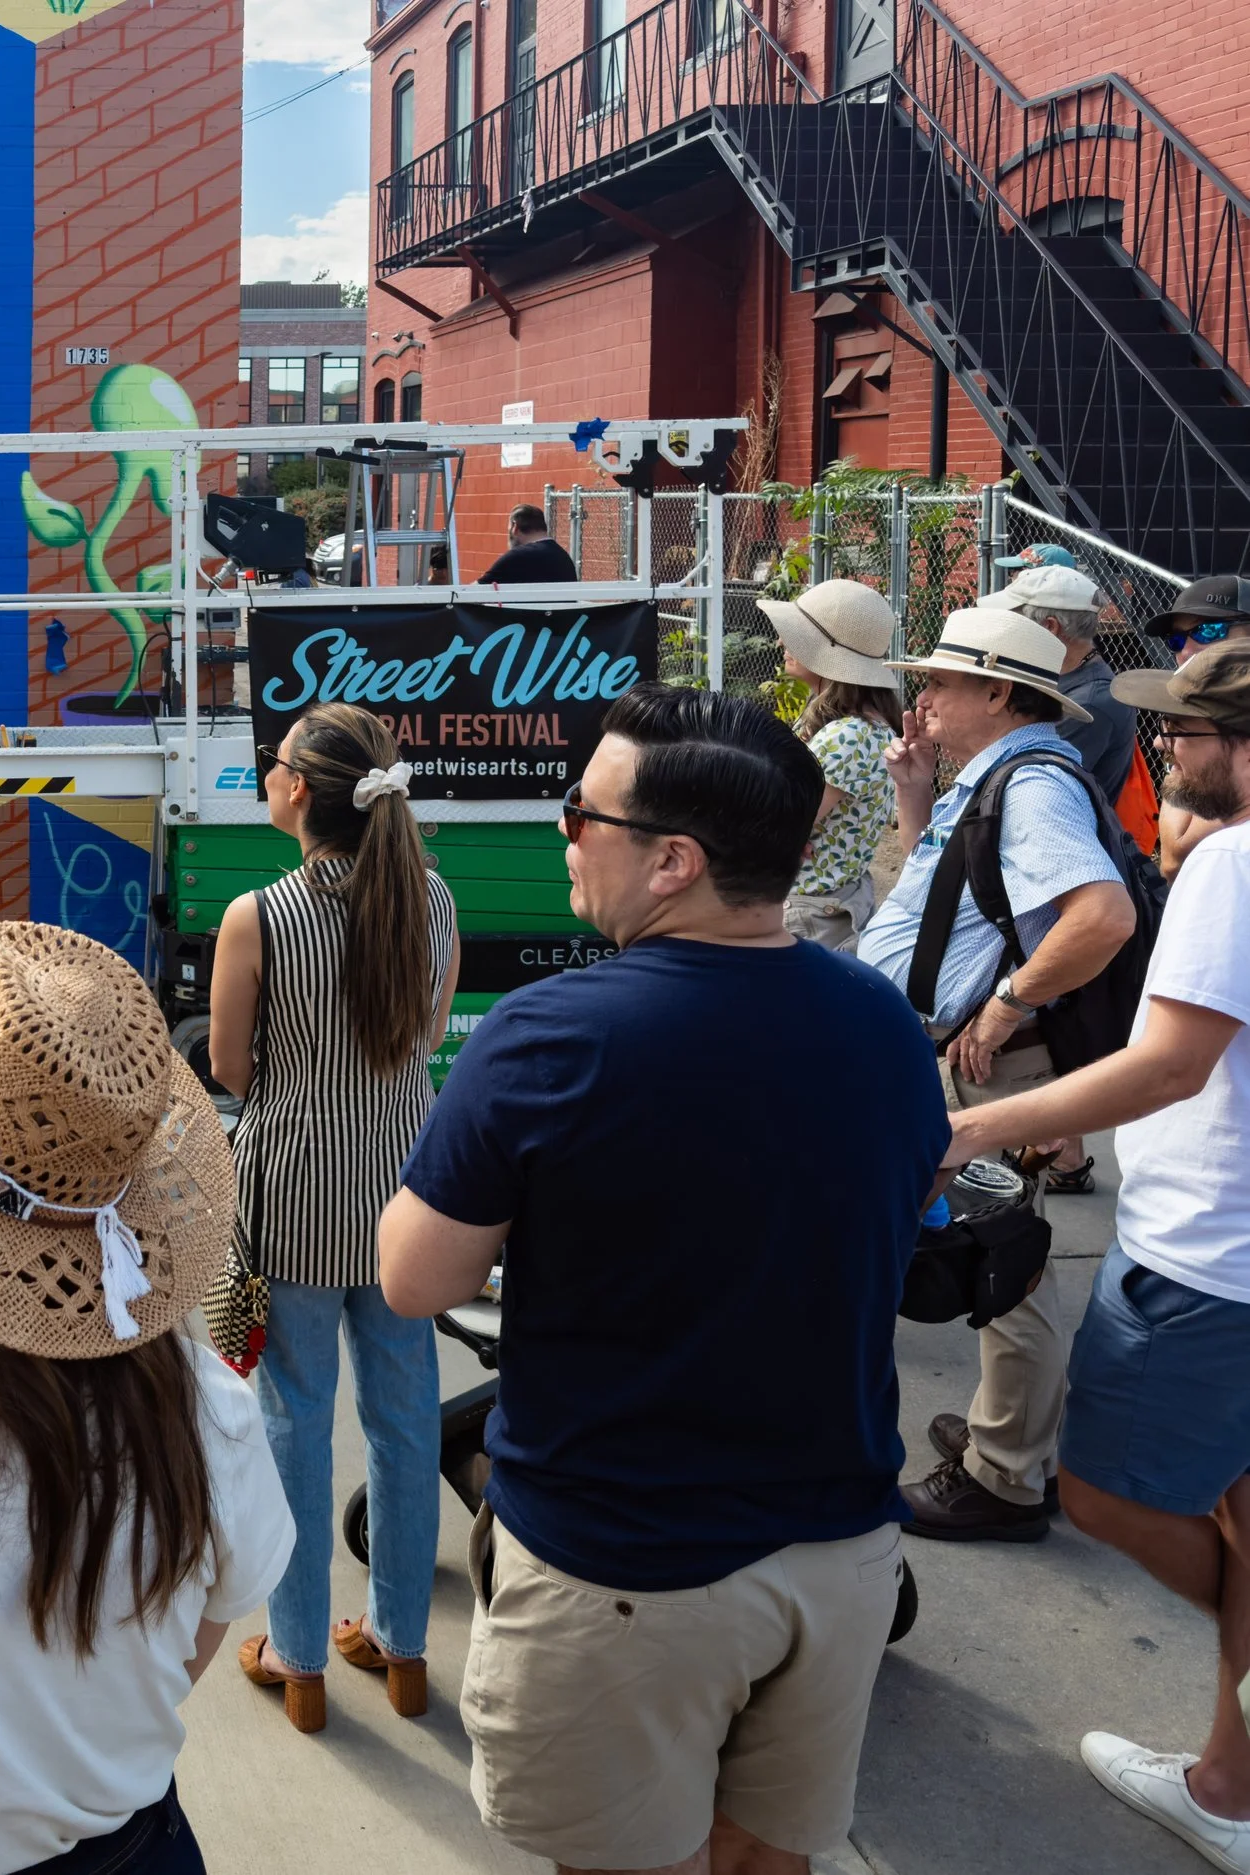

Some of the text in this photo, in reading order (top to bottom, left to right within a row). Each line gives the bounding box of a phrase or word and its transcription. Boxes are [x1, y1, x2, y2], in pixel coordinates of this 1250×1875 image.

[68, 348, 108, 364] 1735
[262, 614, 641, 712] Street Wise
[439, 713, 569, 746] FESTIVAL
[519, 948, 622, 965] CLEARS
